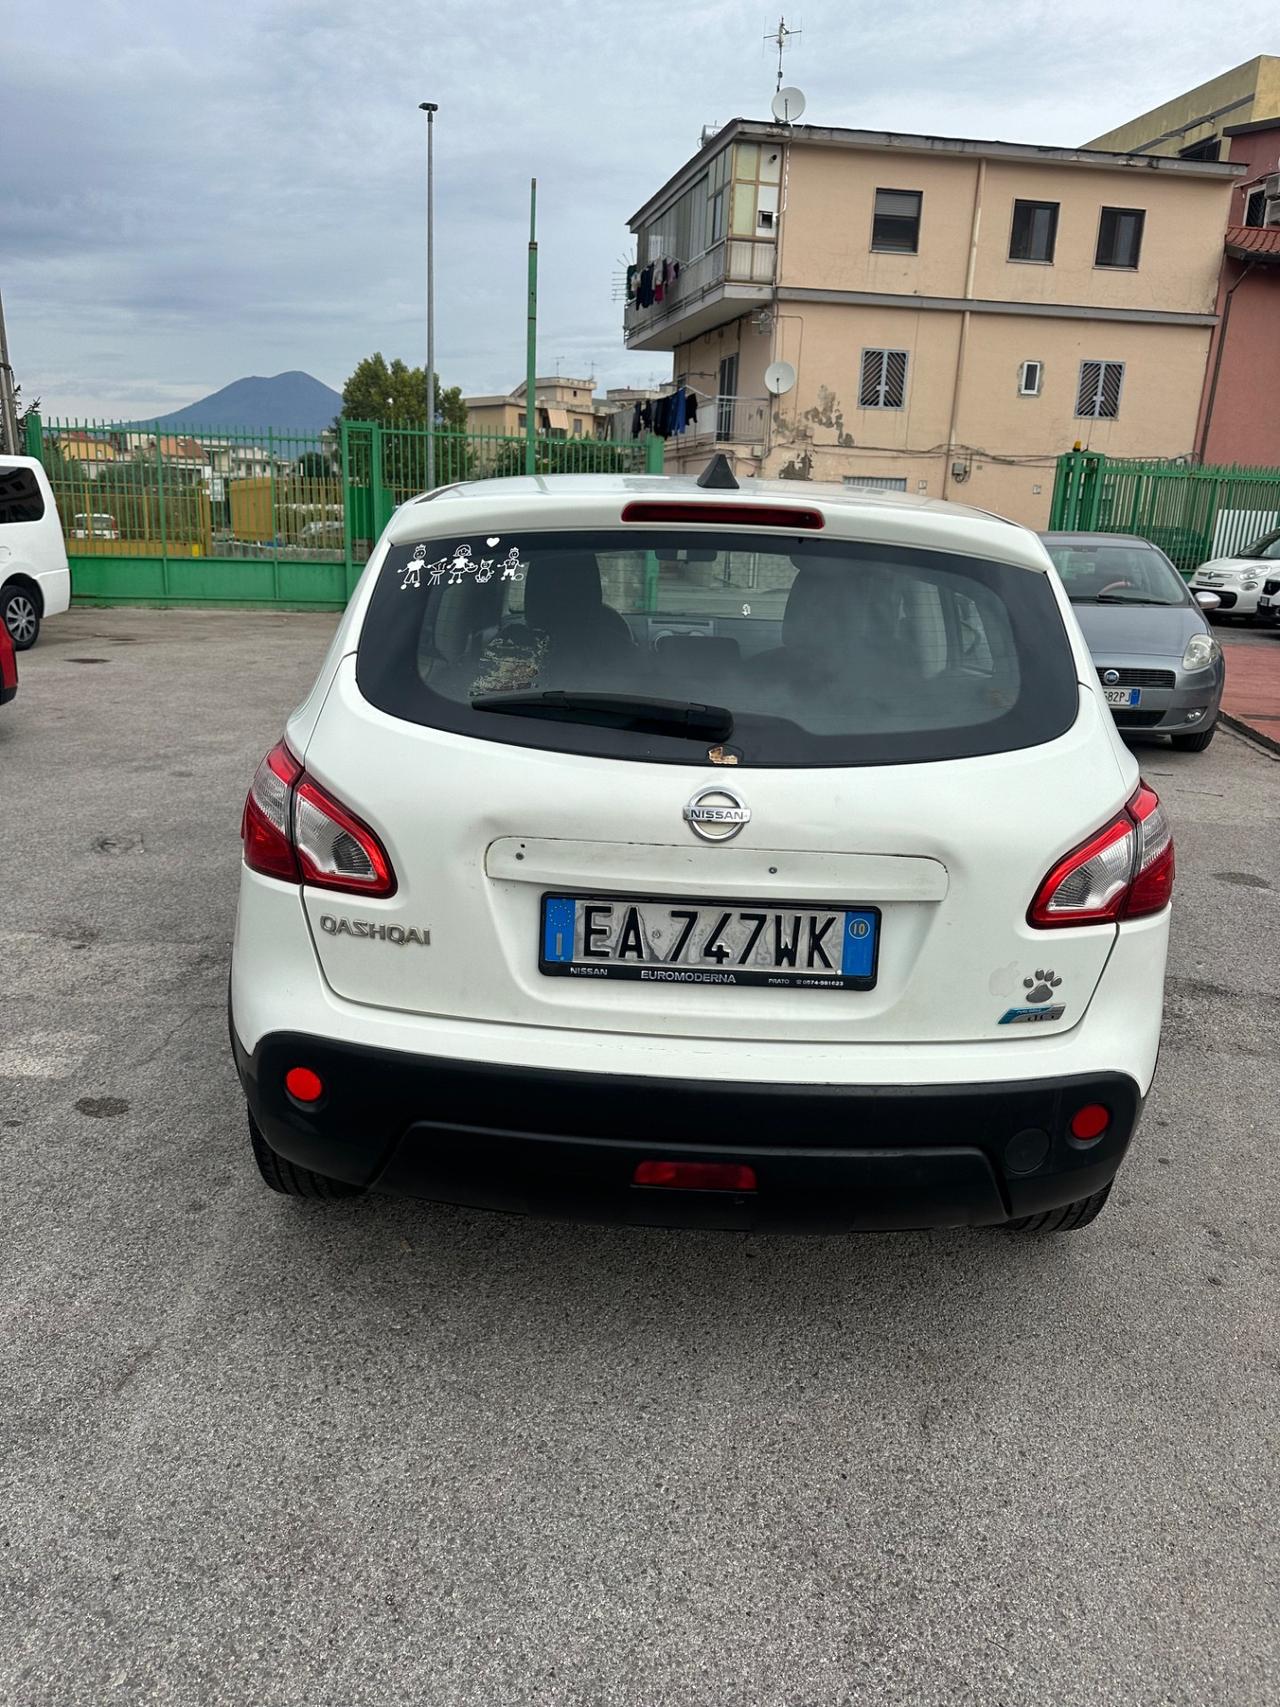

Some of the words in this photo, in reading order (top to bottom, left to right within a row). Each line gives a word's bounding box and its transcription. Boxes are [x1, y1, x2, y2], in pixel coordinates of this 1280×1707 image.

[690, 809, 744, 820] NISSAN
[320, 913, 431, 945] QASHQAI
[853, 922, 865, 935] 10
[583, 905, 646, 959] EA
[669, 910, 837, 968] 747WK
[570, 967, 608, 976] NISSAN
[641, 970, 737, 984] EUROMODERNA
